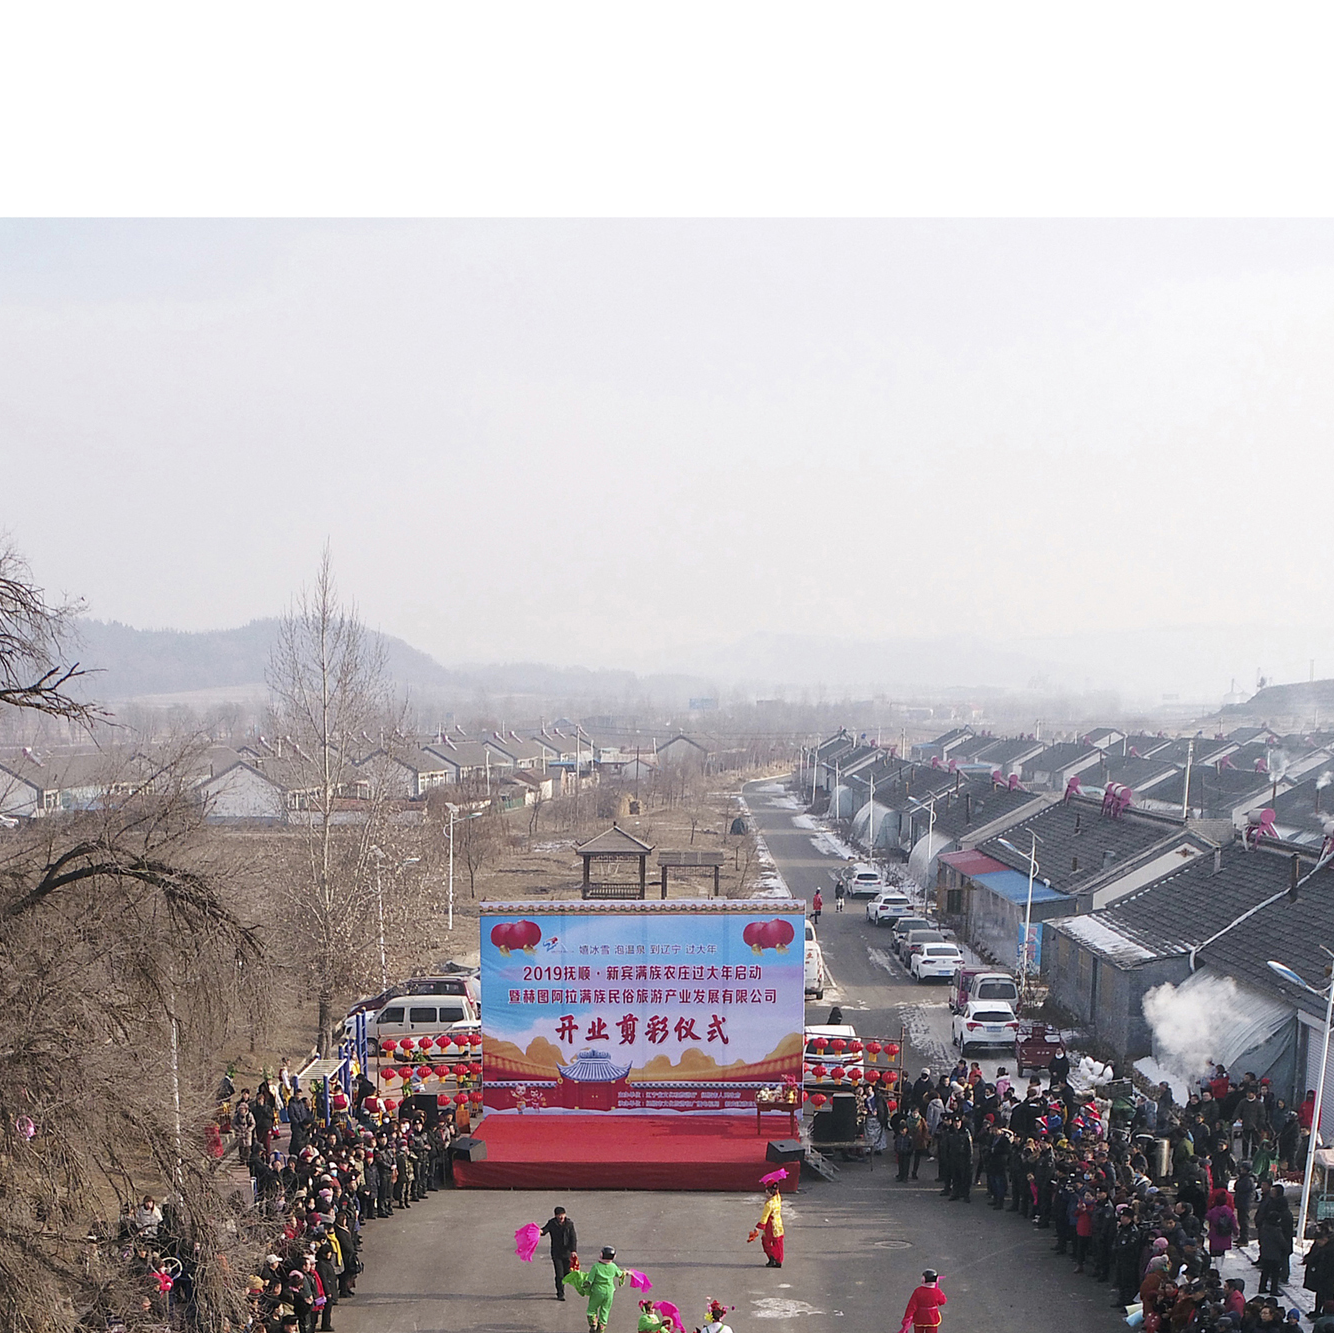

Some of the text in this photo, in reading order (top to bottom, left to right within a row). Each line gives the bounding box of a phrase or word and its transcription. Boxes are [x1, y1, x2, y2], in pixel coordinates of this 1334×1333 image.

[615, 944, 645, 955] 泡温泉
[650, 944, 681, 955] 到辽宁
[685, 944, 717, 955] 过大年
[508, 988, 777, 1005] 暨赫图阿拉满族民俗旅游产业发展有限公司
[555, 1013, 730, 1045] 开业剪彩仪式
